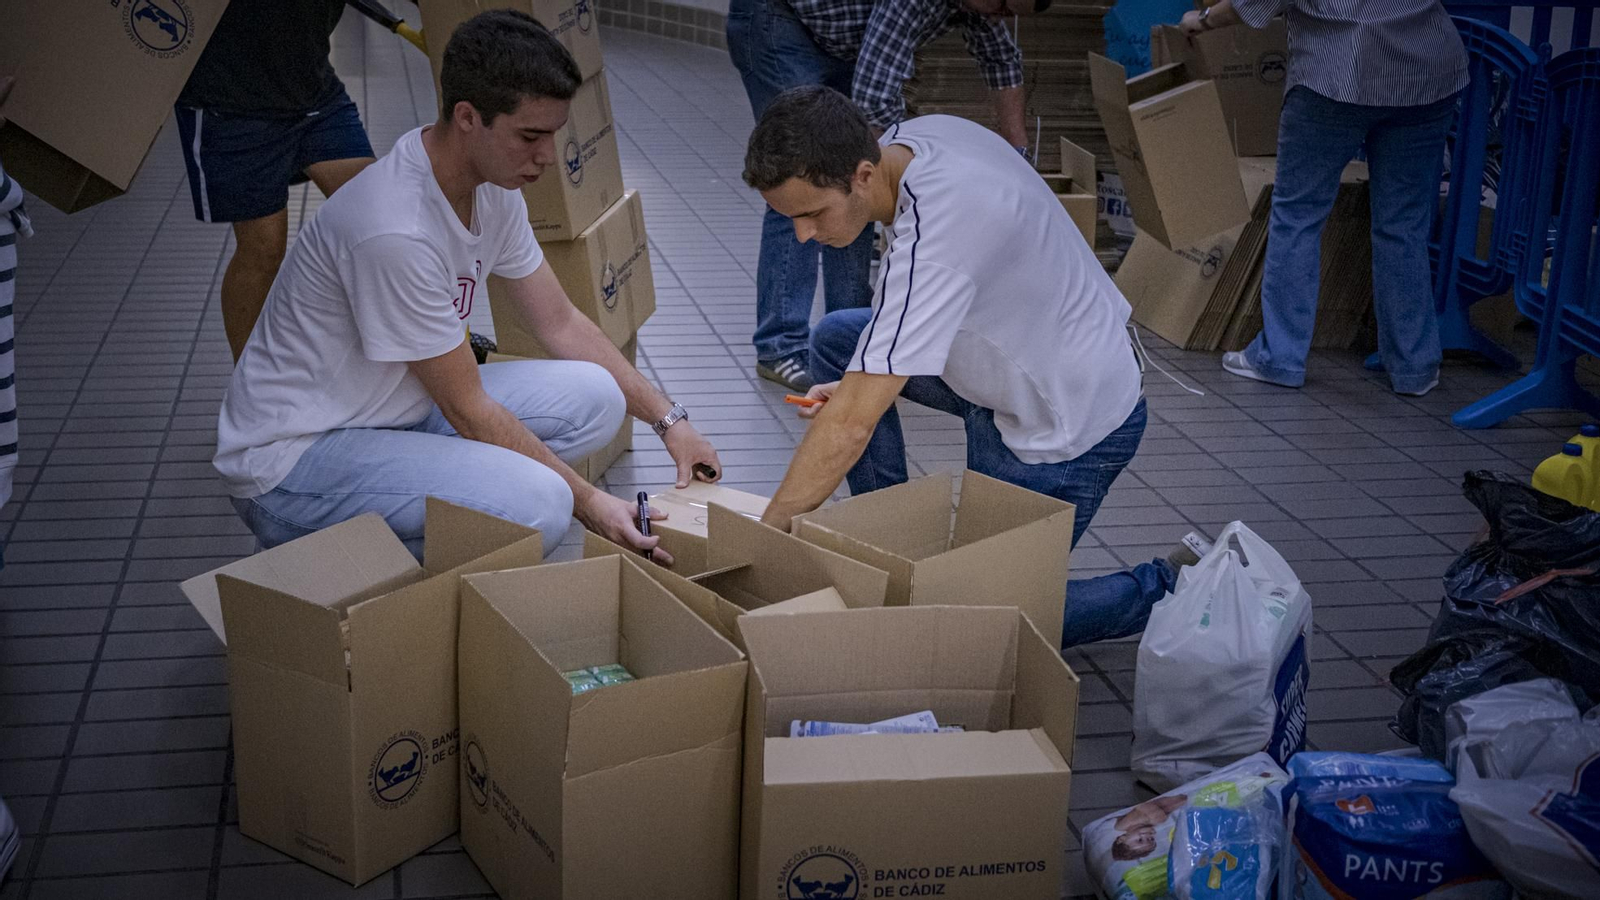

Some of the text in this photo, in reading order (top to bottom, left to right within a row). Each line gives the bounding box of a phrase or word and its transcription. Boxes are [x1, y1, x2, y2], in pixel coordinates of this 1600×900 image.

[144, 47, 156, 57] DE
[432, 728, 460, 750] BANC
[432, 750, 446, 765] DE
[777, 845, 870, 883] BANCOS DE ALIMENTOS
[874, 860, 1047, 883] BANCO DE ALIMENTOS
[1344, 854, 1444, 884] PANTS
[873, 883, 946, 899] DE CÁDIZ
